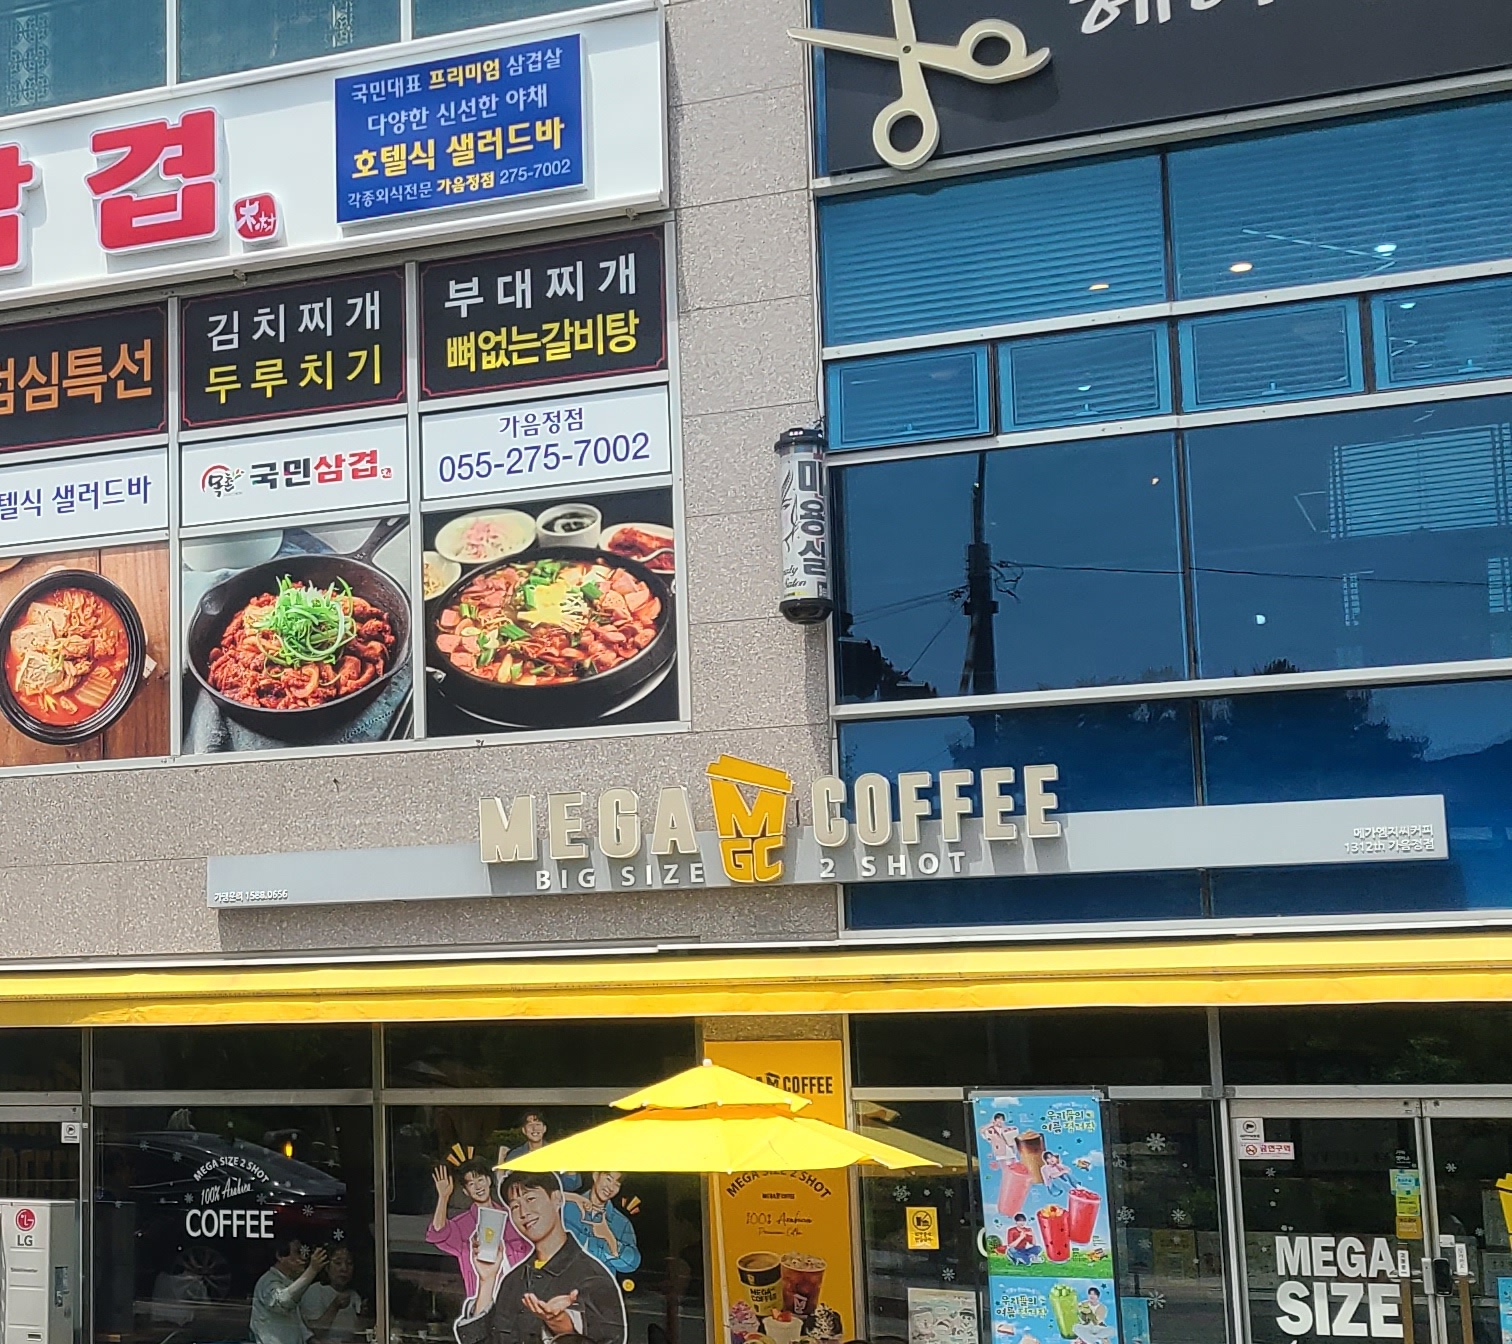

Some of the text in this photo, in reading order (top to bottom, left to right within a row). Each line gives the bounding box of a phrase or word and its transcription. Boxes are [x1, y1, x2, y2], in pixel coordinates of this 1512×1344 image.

[351, 47, 563, 103] 국민대표 프리미엄 삼겹살
[367, 83, 548, 136] 다양한 신선한 야채
[352, 117, 565, 179] 호텔식 샐러드바
[347, 159, 571, 208] 각종외식전문 가음정점 275-7002
[445, 253, 639, 318] 부대찌개
[205, 289, 382, 352] 김치찌개
[446, 309, 640, 373] 뼈없는갈비탕
[204, 344, 382, 406] 두루치기
[498, 406, 585, 438] 가음정점
[250, 449, 378, 489] 국민삼겹
[439, 432, 651, 485] 055-275-7002
[52, 475, 152, 516] 샐러드바
[479, 765, 1061, 863] MEGA COFFEE
[1388, 838, 1435, 853] 가음정점
[535, 851, 967, 891] BIG SIZE 2 SHOT
[782, 1075, 833, 1095] COFFEE
[193, 1156, 269, 1183] MEGA SIZE 2 SHOT
[797, 1170, 832, 1199] SHOT
[17, 1235, 33, 1247] LG
[186, 1209, 275, 1238] COFFEE
[1275, 1234, 1398, 1278] MEGA
[1275, 1280, 1404, 1338] SIZE
